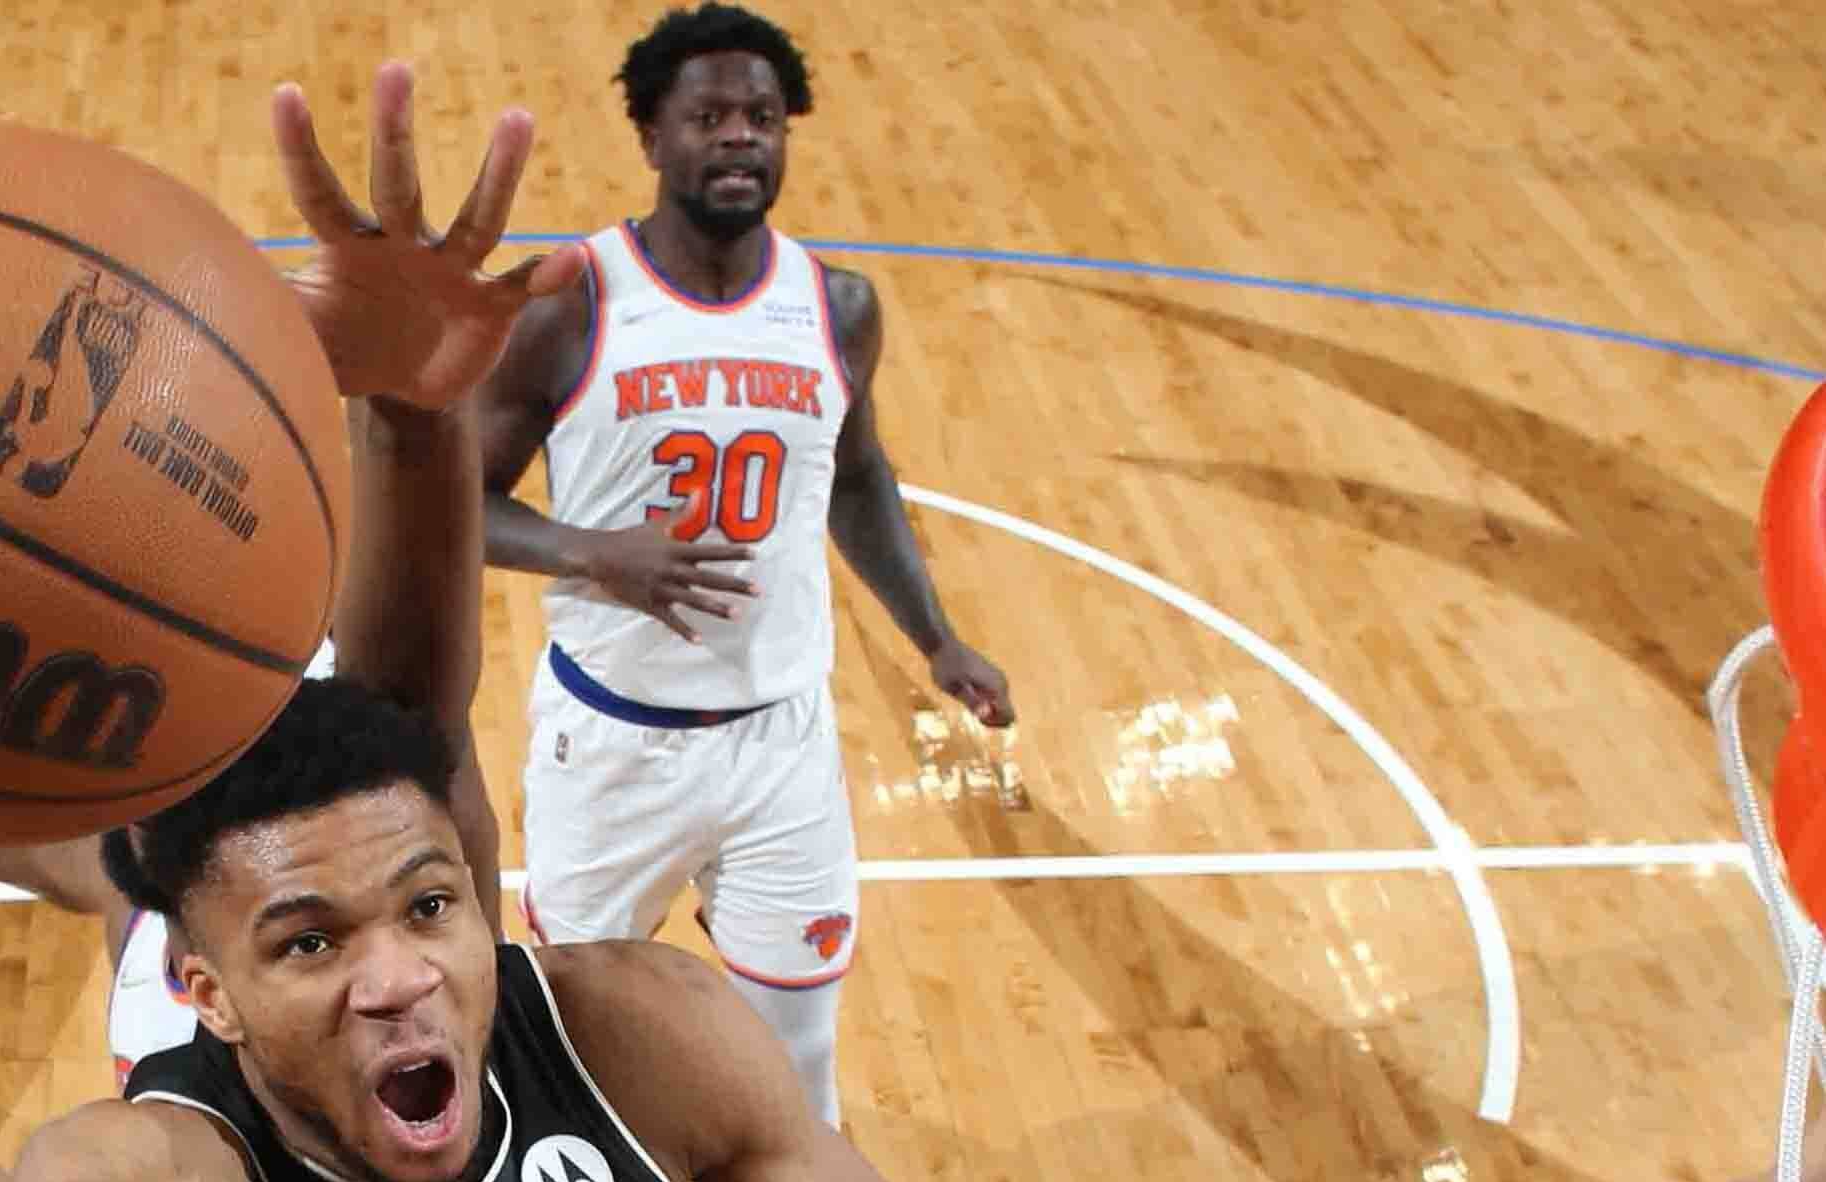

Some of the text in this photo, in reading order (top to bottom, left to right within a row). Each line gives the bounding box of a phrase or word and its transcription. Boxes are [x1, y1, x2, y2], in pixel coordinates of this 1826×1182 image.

[613, 360, 823, 421] NEW YORK
[645, 431, 787, 543] 30
